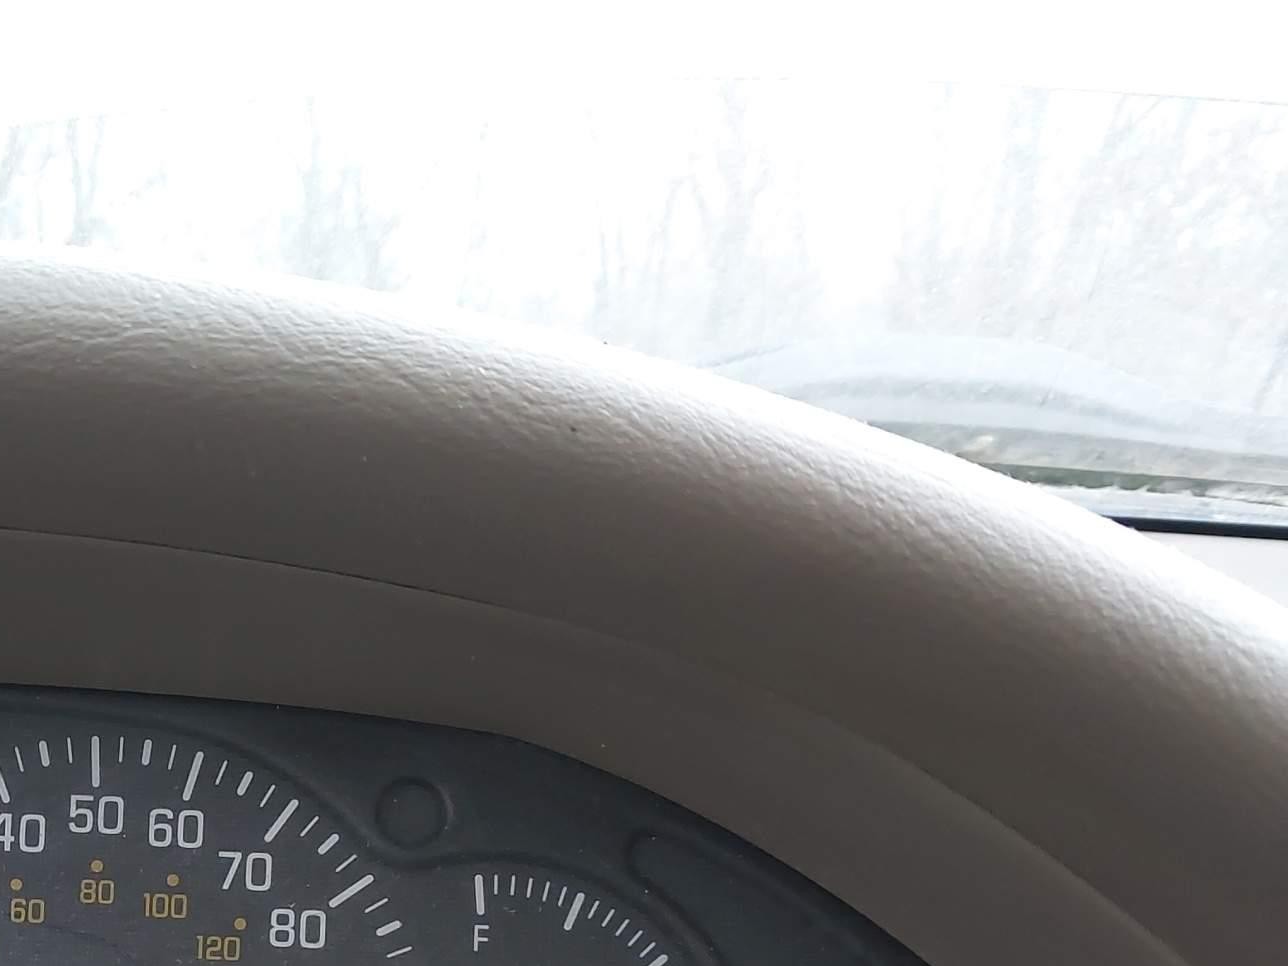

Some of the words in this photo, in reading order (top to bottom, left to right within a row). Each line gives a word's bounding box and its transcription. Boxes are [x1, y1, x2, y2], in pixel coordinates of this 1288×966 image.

[69, 796, 124, 834] 50
[148, 809, 204, 848] 60
[218, 852, 272, 891] 70
[80, 881, 114, 904] 80
[10, 900, 45, 923] 60
[144, 894, 187, 918] 100
[269, 909, 326, 948] 80
[473, 925, 489, 951] F
[196, 936, 240, 960] 120
